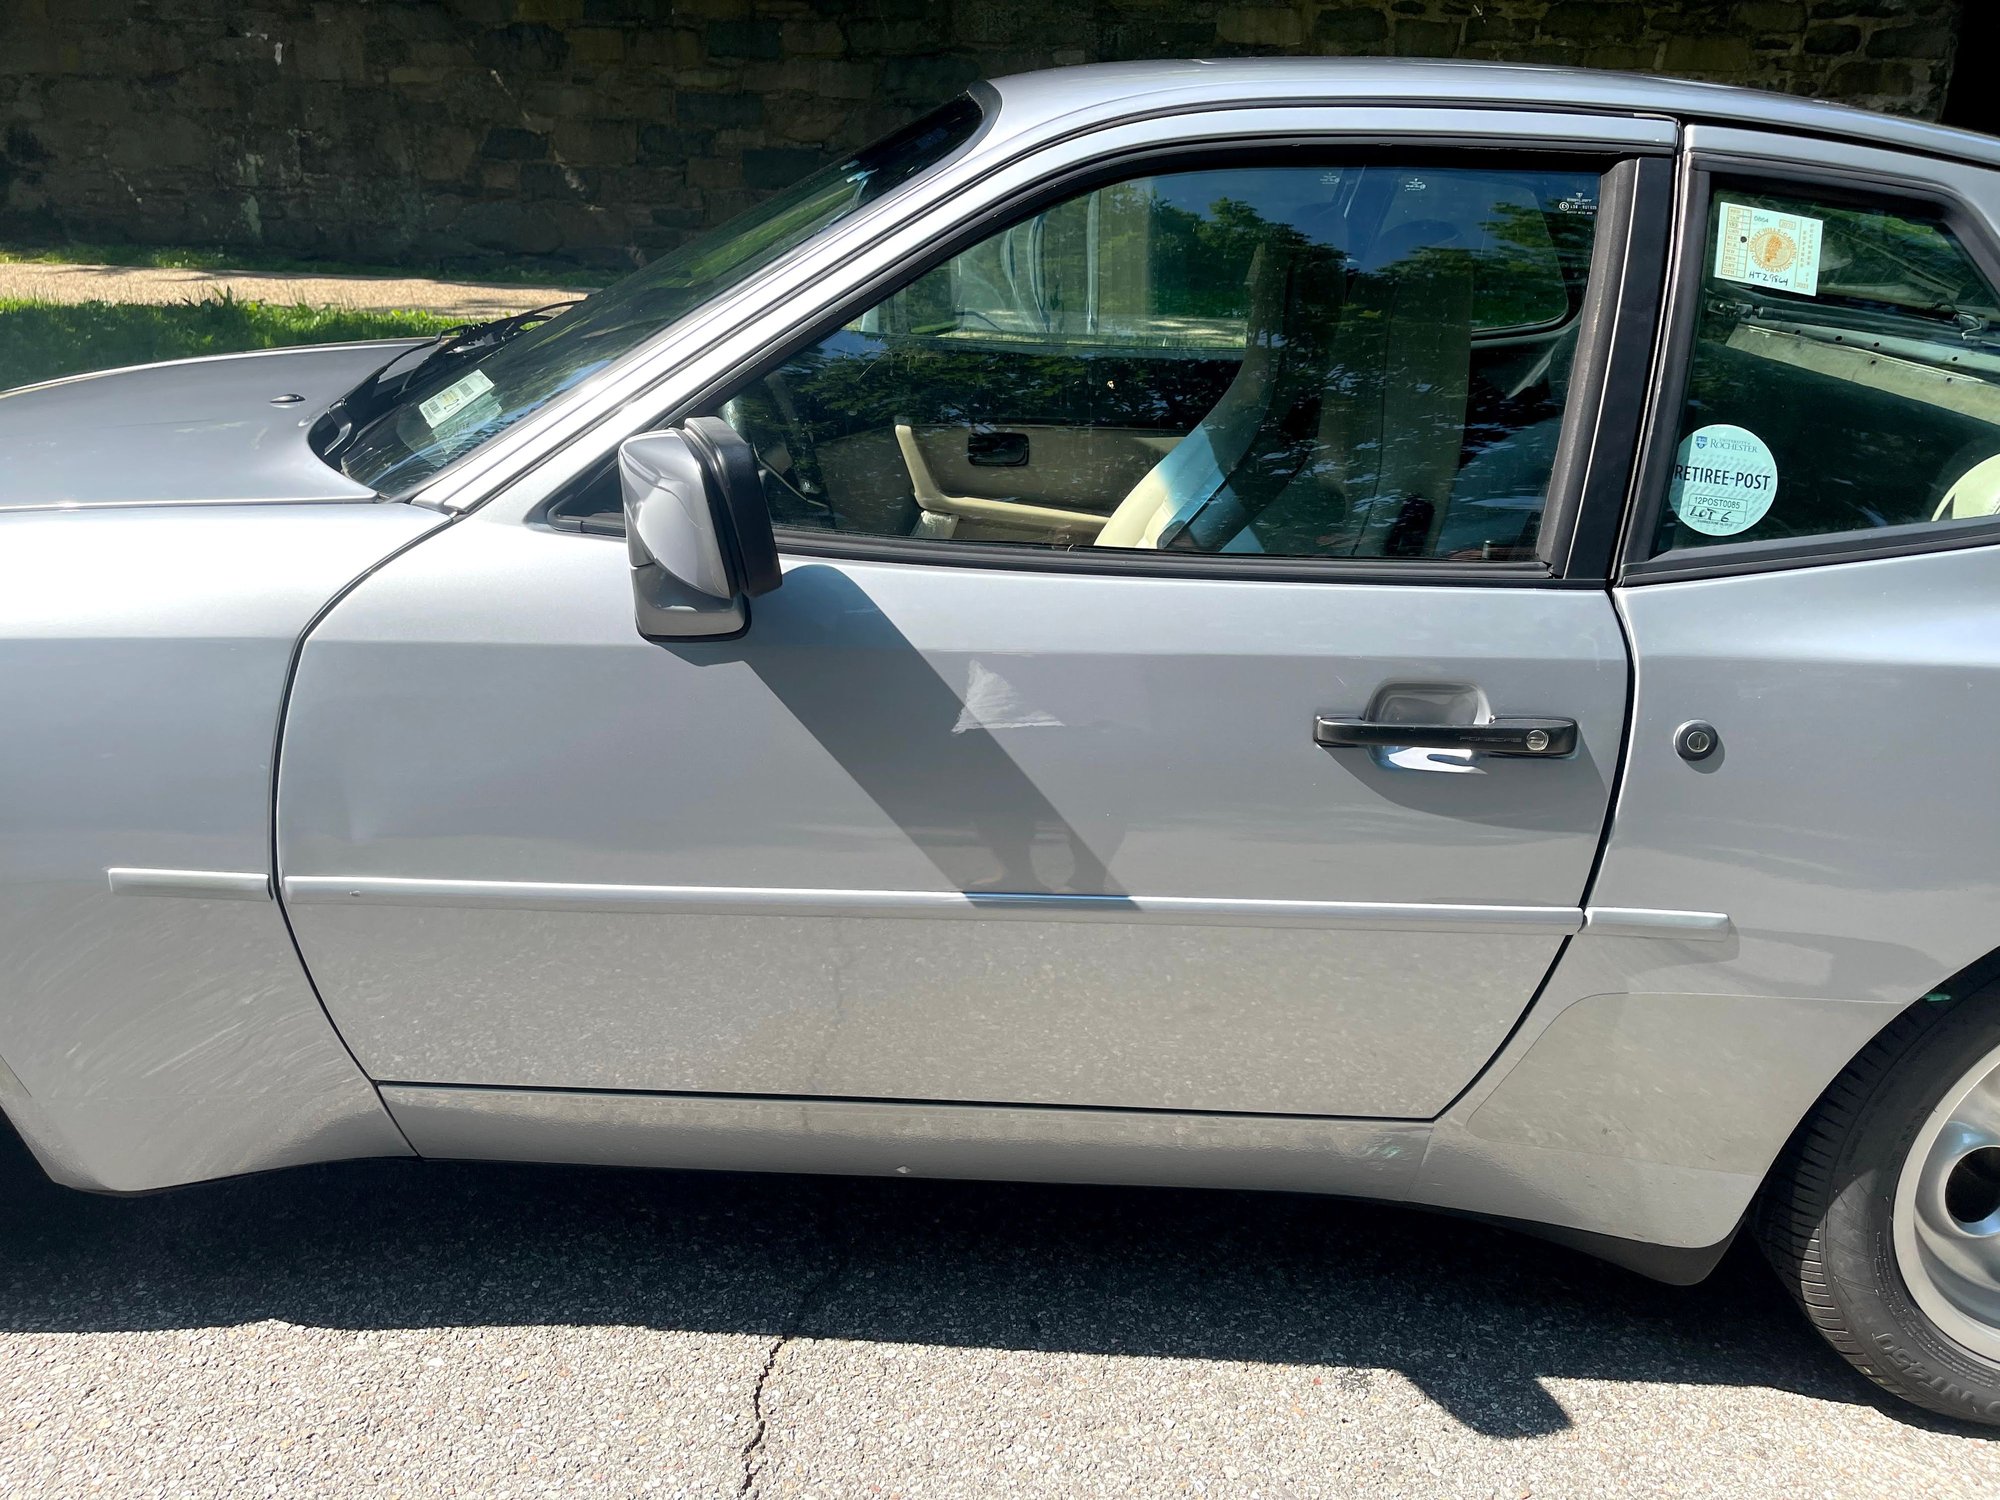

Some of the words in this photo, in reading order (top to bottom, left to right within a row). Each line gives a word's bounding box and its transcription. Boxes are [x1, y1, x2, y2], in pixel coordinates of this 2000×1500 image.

[1710, 438, 1758, 453] ROCHESTER
[1674, 464, 1771, 491] RETIREE-POST
[1694, 496, 1741, 510] 12POST0085
[1690, 506, 1716, 520] LOT
[1721, 511, 1732, 522] 6
